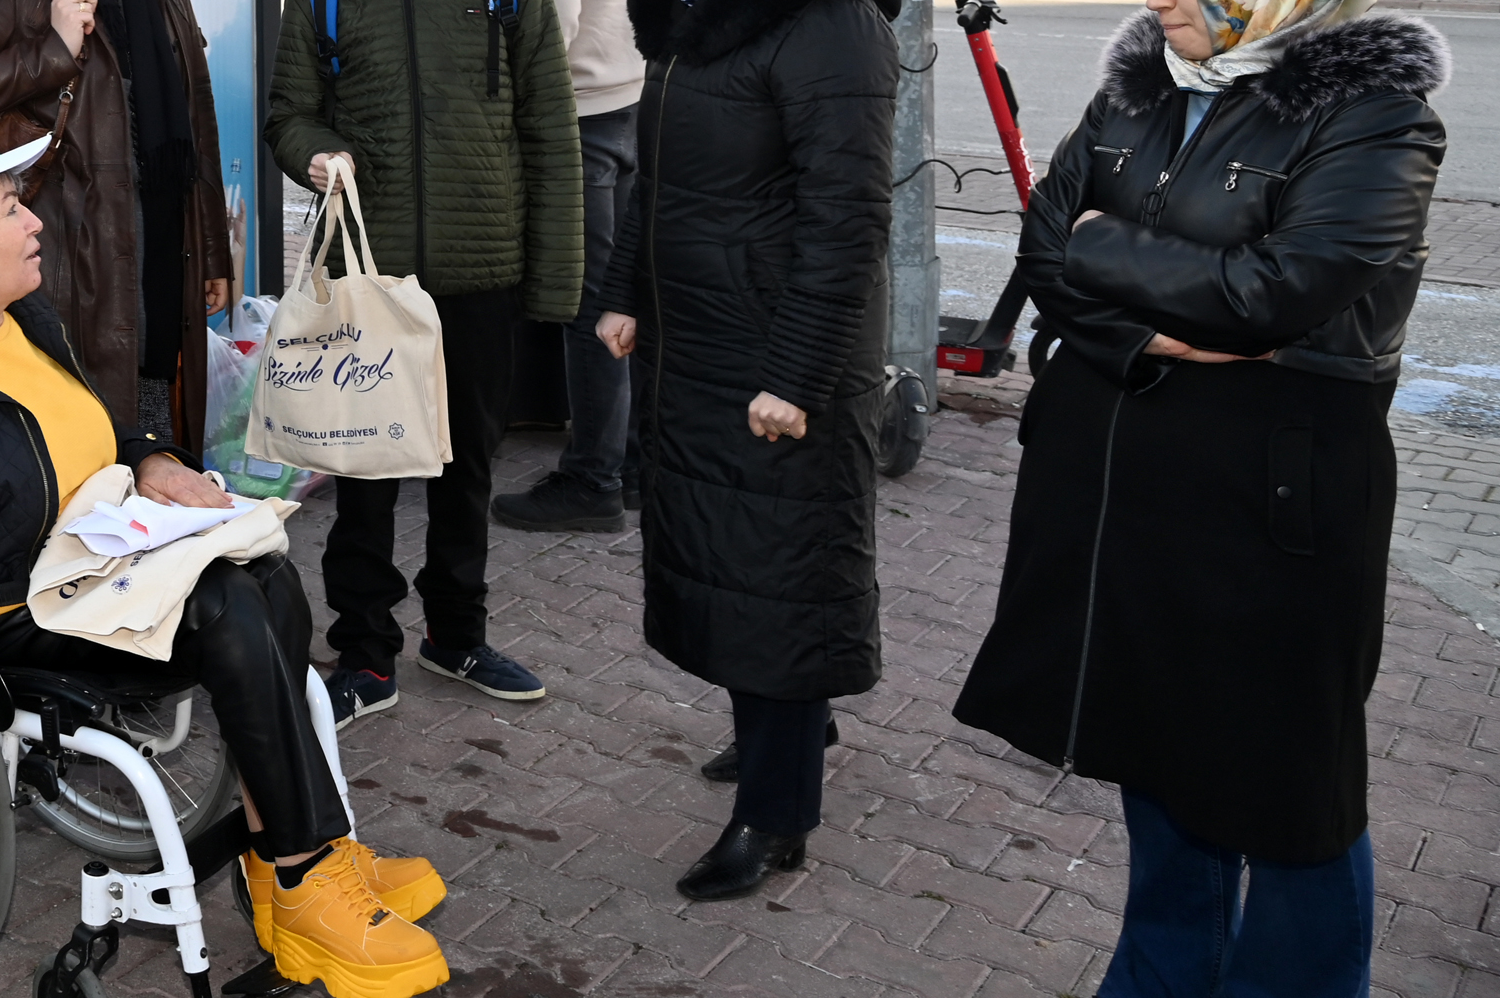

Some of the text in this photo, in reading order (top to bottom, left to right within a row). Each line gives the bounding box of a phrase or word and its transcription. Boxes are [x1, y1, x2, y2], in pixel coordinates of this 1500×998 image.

[264, 348, 394, 392] Sizinle Güzel
[282, 425, 327, 439] SELÇUKLU
[329, 426, 378, 439] BELEDİYESİ
